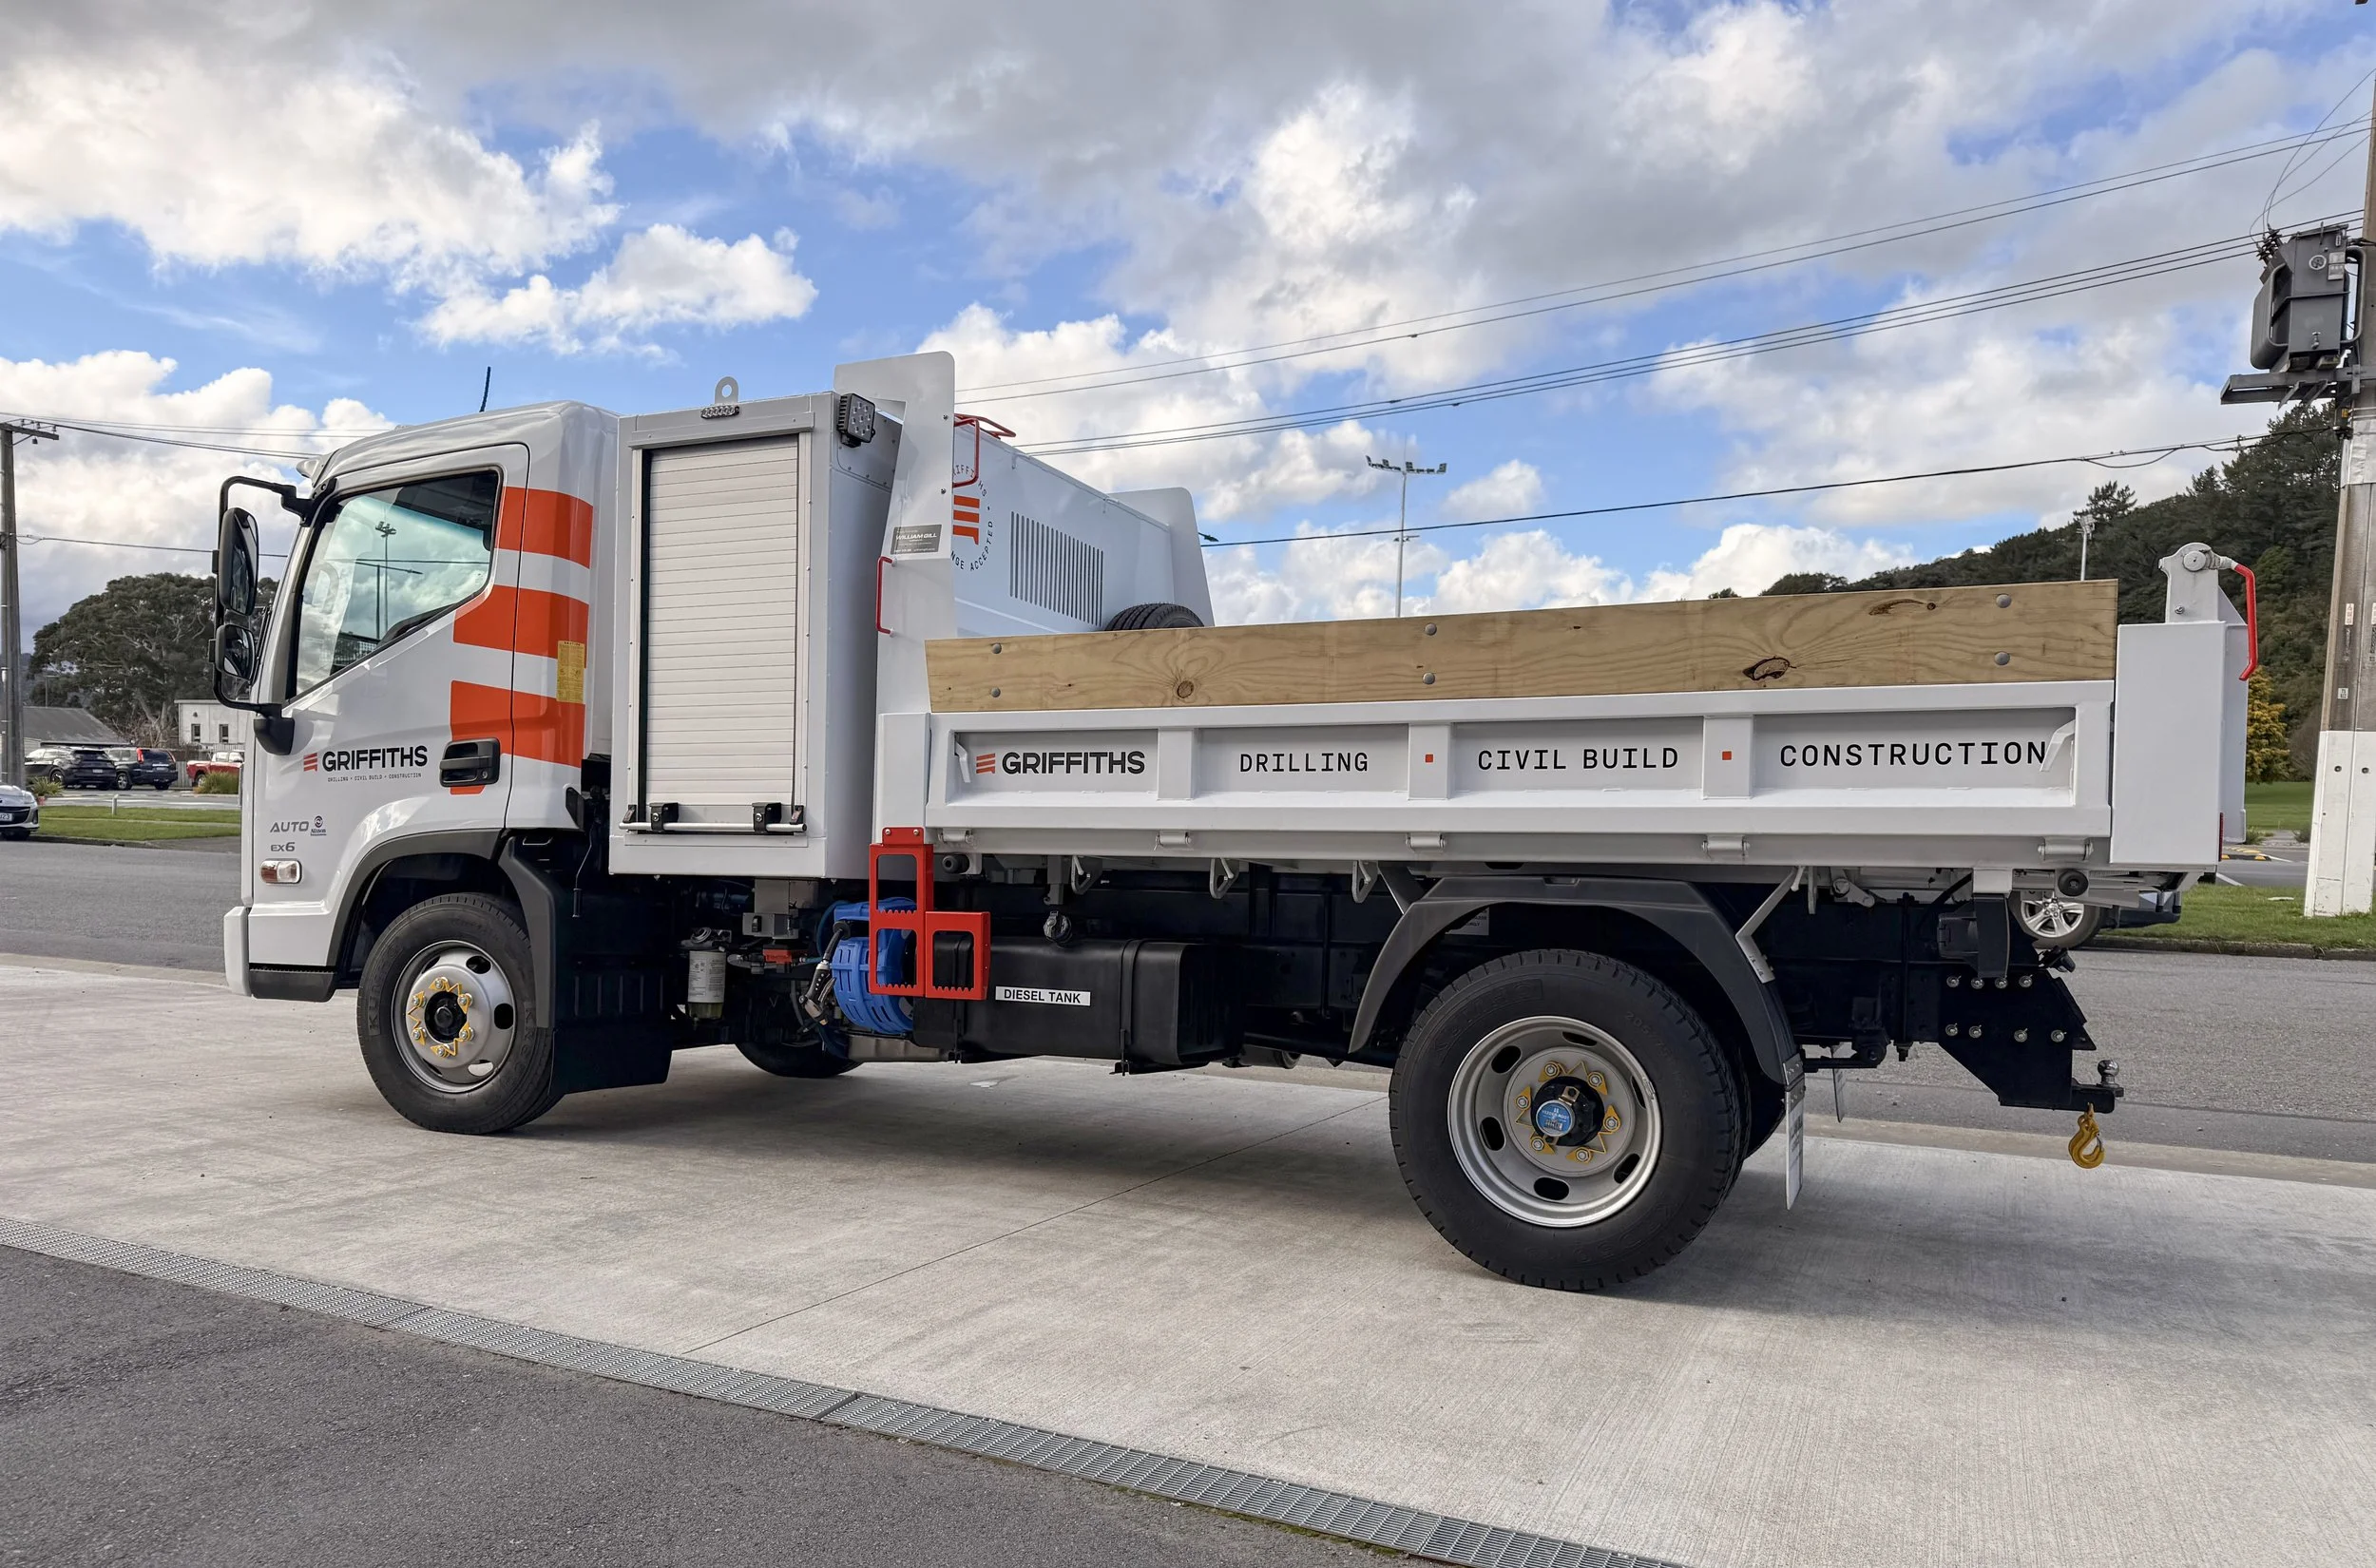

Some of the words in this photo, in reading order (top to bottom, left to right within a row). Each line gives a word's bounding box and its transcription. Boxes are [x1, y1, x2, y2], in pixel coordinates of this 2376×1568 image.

[322, 746, 428, 772] GRIFFITHS
[1003, 751, 1145, 774] GRIFFITHS
[1240, 752, 1369, 773] DRILLING
[1478, 749, 1566, 770] CIVIL
[1582, 747, 1679, 769] BUILD
[1779, 741, 2045, 767] CONSTRUCTION
[270, 821, 309, 832] AUTO
[271, 842, 296, 852] EX6
[1004, 989, 1044, 1001] DIESEL
[1048, 992, 1081, 1004] TANK
